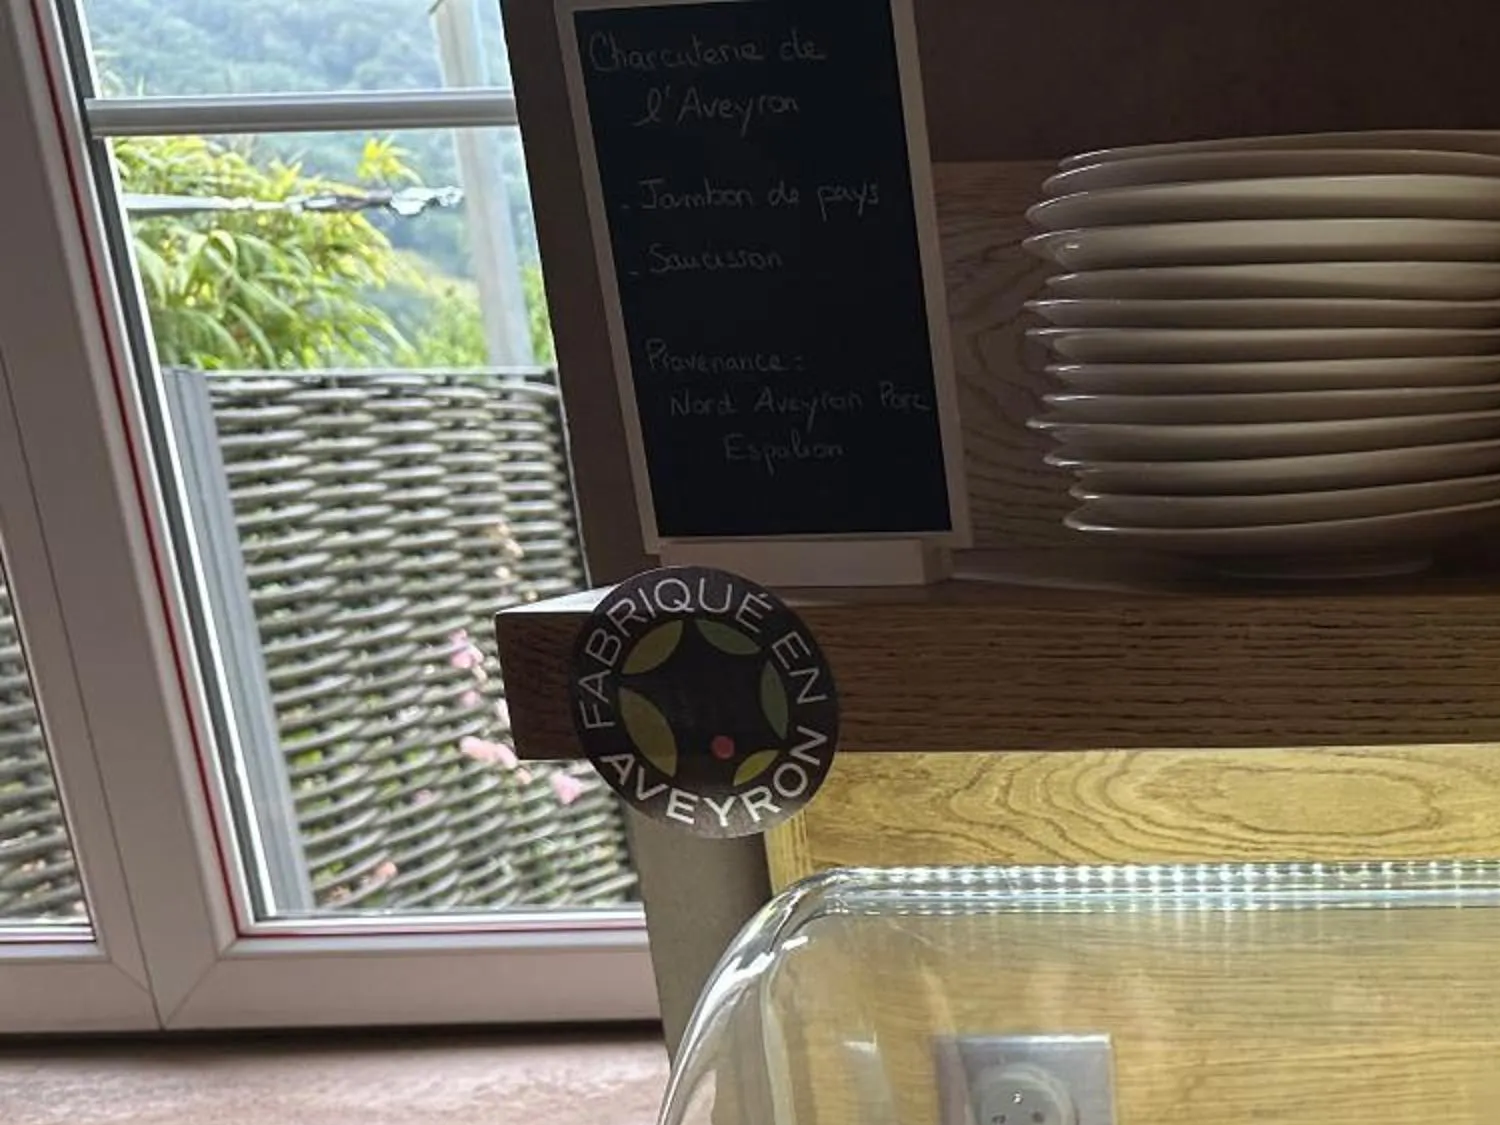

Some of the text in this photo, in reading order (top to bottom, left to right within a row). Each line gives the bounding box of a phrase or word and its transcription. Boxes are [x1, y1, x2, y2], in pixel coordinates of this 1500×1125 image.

[588, 27, 827, 73] Charcuterie de
[632, 85, 801, 138] l'Aveyron
[637, 177, 880, 222] Jambon de pays
[649, 243, 784, 274] Saucisson
[670, 388, 739, 417] Nord
[753, 385, 864, 433] Aveyron
[771, 631, 828, 705] EN
[601, 725, 829, 828] AVEYRON
